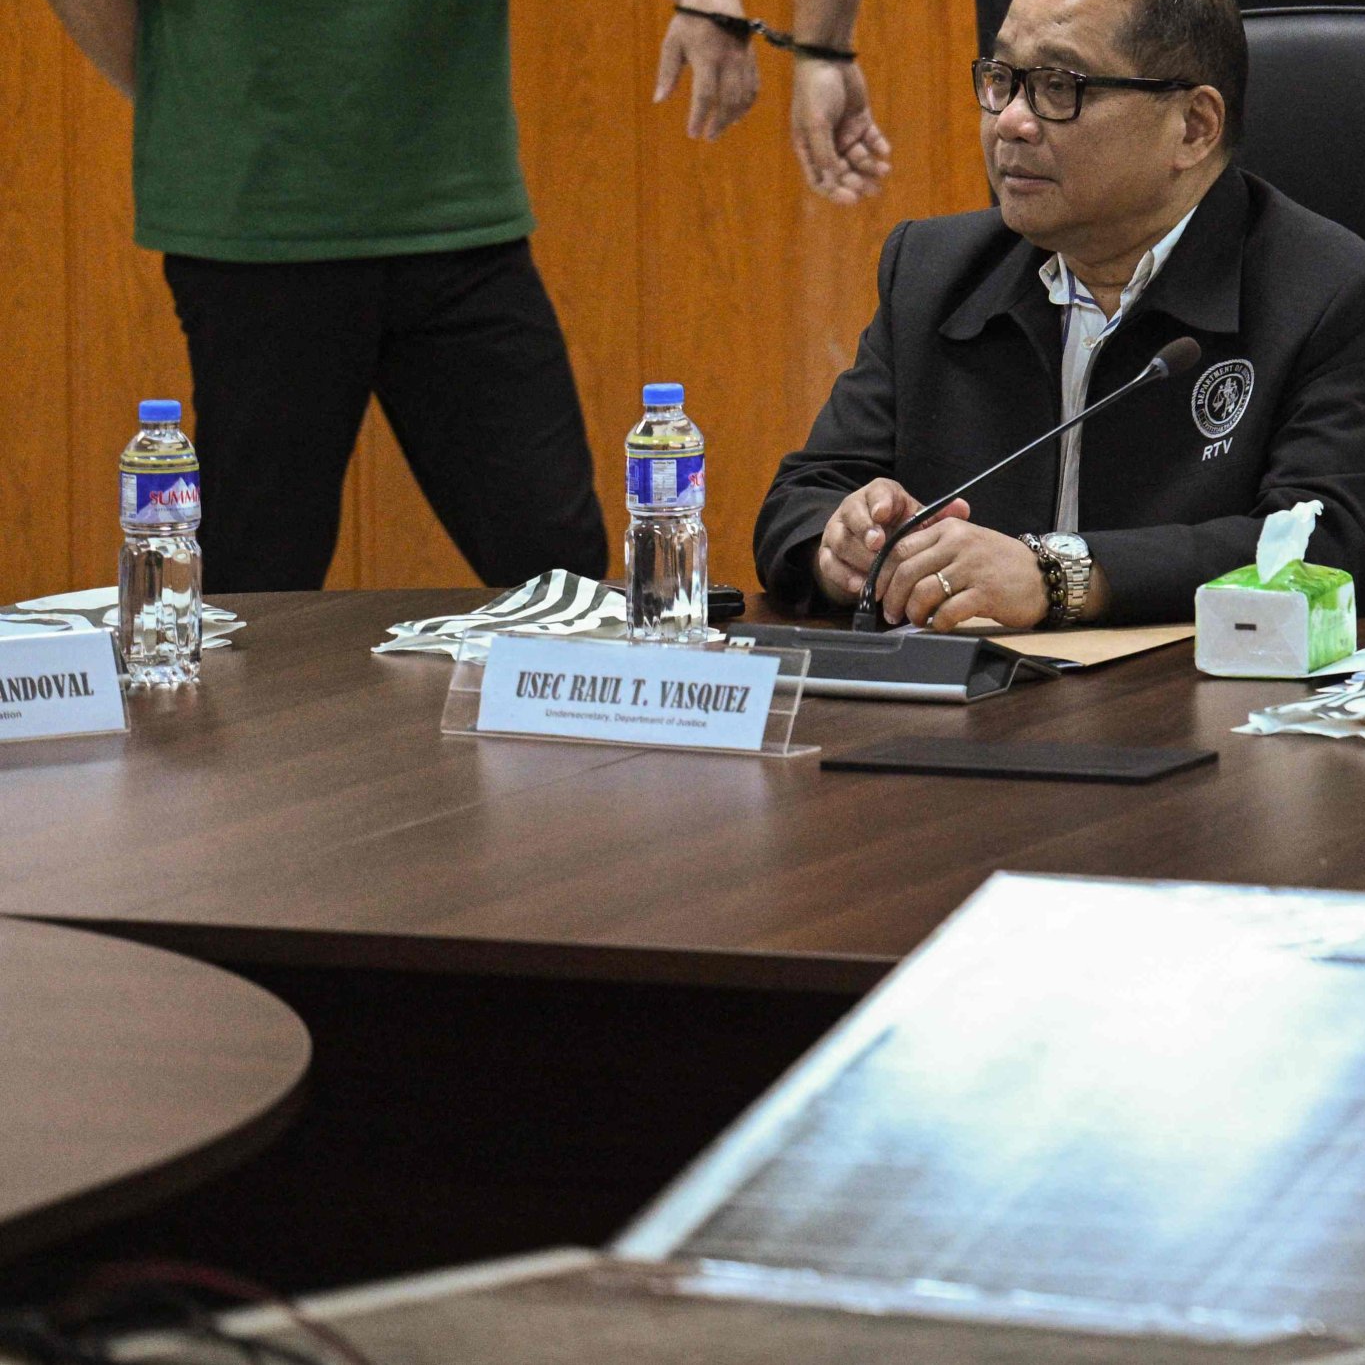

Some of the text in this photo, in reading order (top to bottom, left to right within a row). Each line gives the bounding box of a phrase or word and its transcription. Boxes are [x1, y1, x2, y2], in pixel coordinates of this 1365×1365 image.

[1202, 437, 1233, 461] RTV
[516, 671, 751, 714] USEC RAUL T. VASQUEZ
[614, 712, 664, 725] Department
[676, 717, 707, 728] Justice
